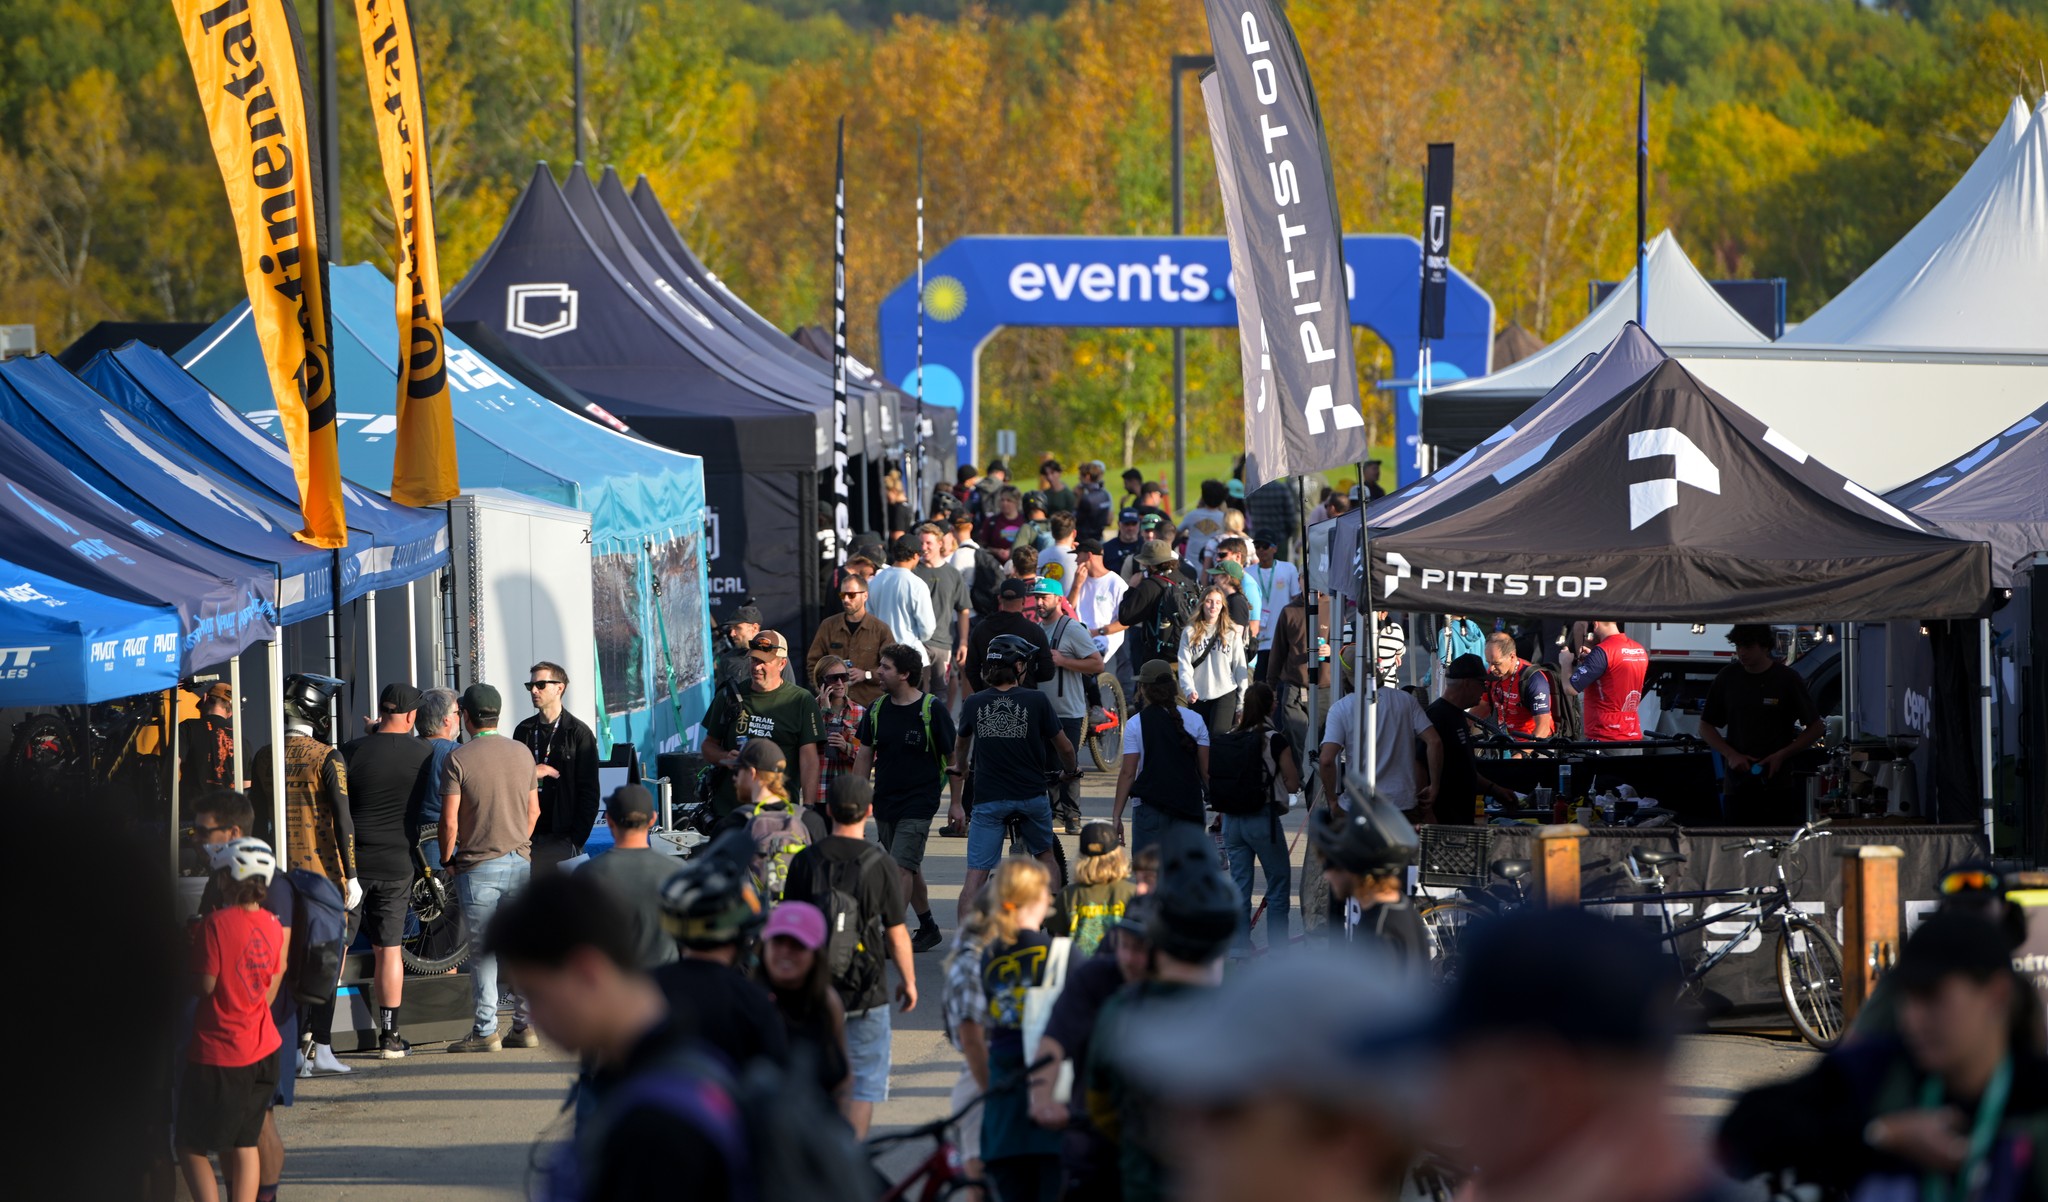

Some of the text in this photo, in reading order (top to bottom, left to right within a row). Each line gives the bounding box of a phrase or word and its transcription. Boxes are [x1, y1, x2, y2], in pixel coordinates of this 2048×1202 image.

[1241, 11, 1336, 364] PITTSTOP
[1421, 568, 1608, 599] PITTSTOP
[91, 640, 119, 663] PIVOT
[122, 635, 149, 658] PIVOT
[153, 633, 178, 654] PIVOT
[749, 721, 774, 731] BUILDERS
[750, 715, 775, 725] TRAIL
[748, 728, 773, 738] MSA
